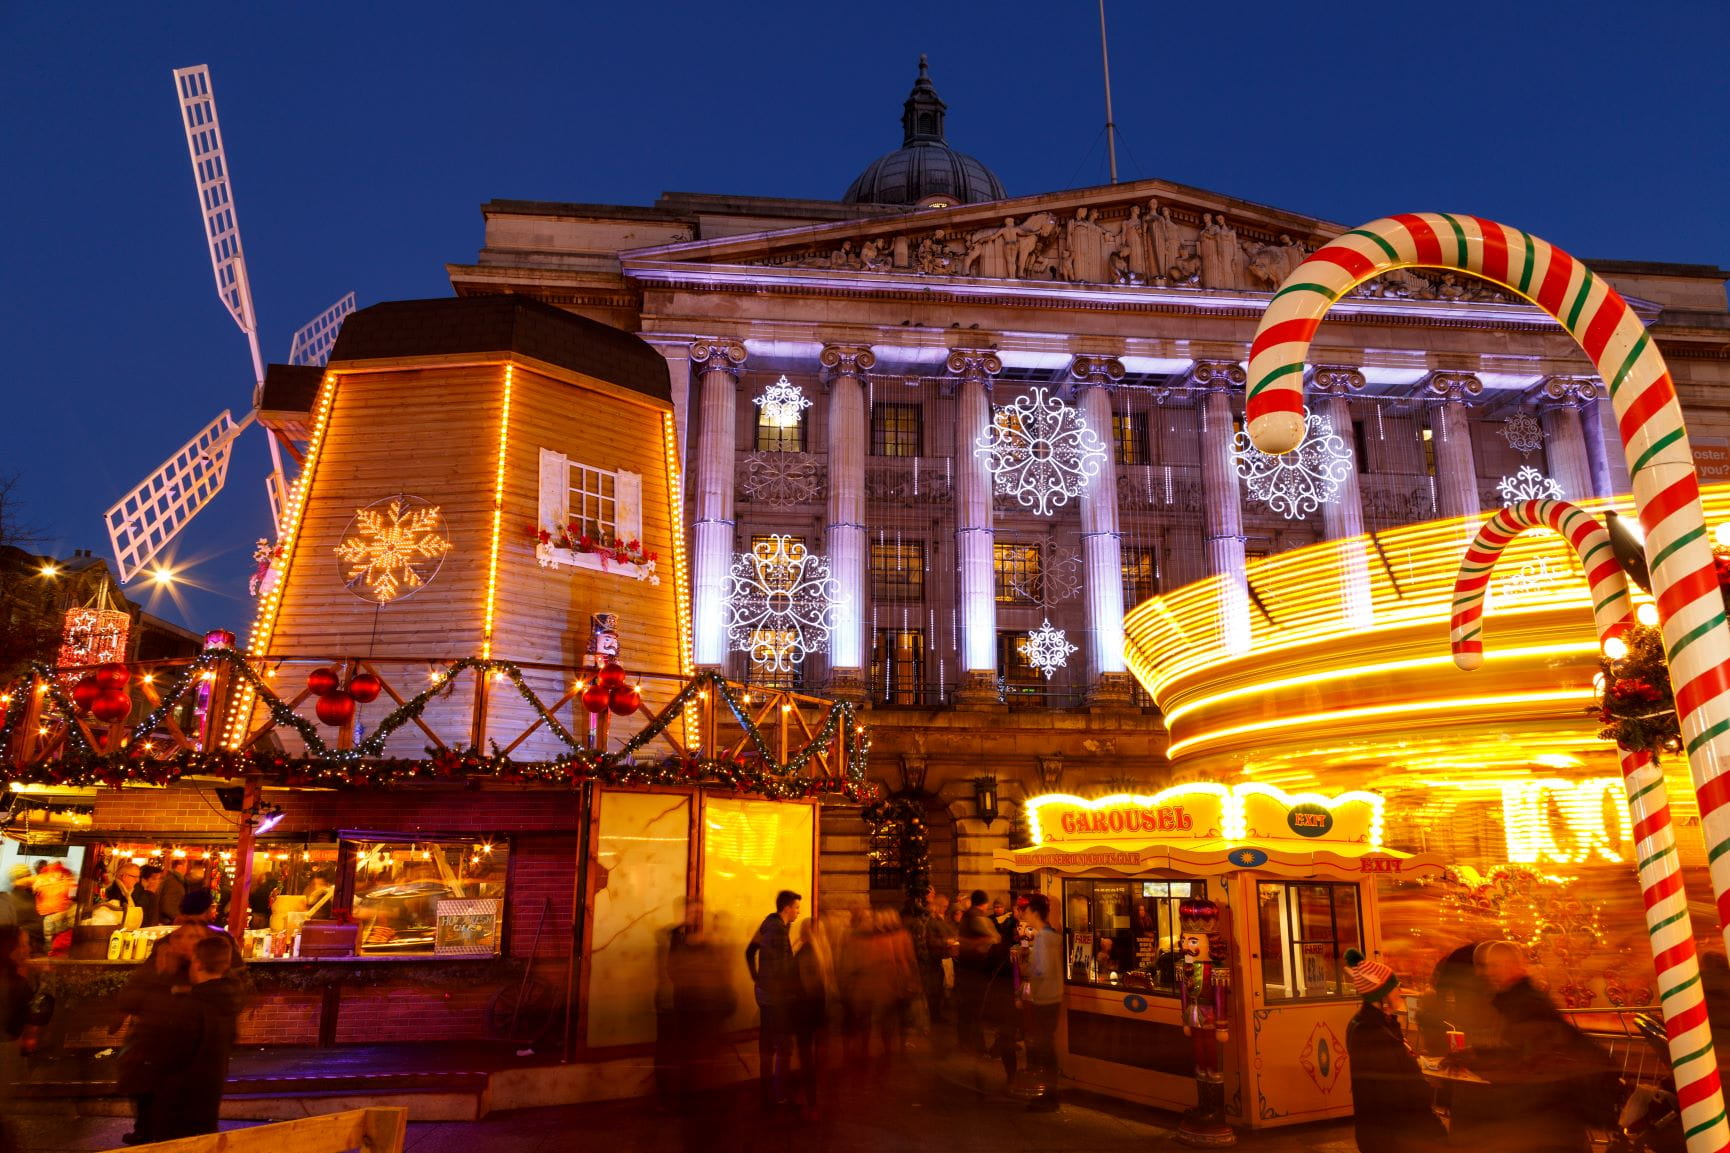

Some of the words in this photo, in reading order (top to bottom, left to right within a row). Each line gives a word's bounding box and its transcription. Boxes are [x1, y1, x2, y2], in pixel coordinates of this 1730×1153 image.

[1692, 449, 1728, 460] oster.
[1700, 465, 1730, 476] you?
[1061, 806, 1193, 834] CAROUSEL
[1295, 813, 1326, 828] EXIT
[1360, 858, 1403, 874] EXIT
